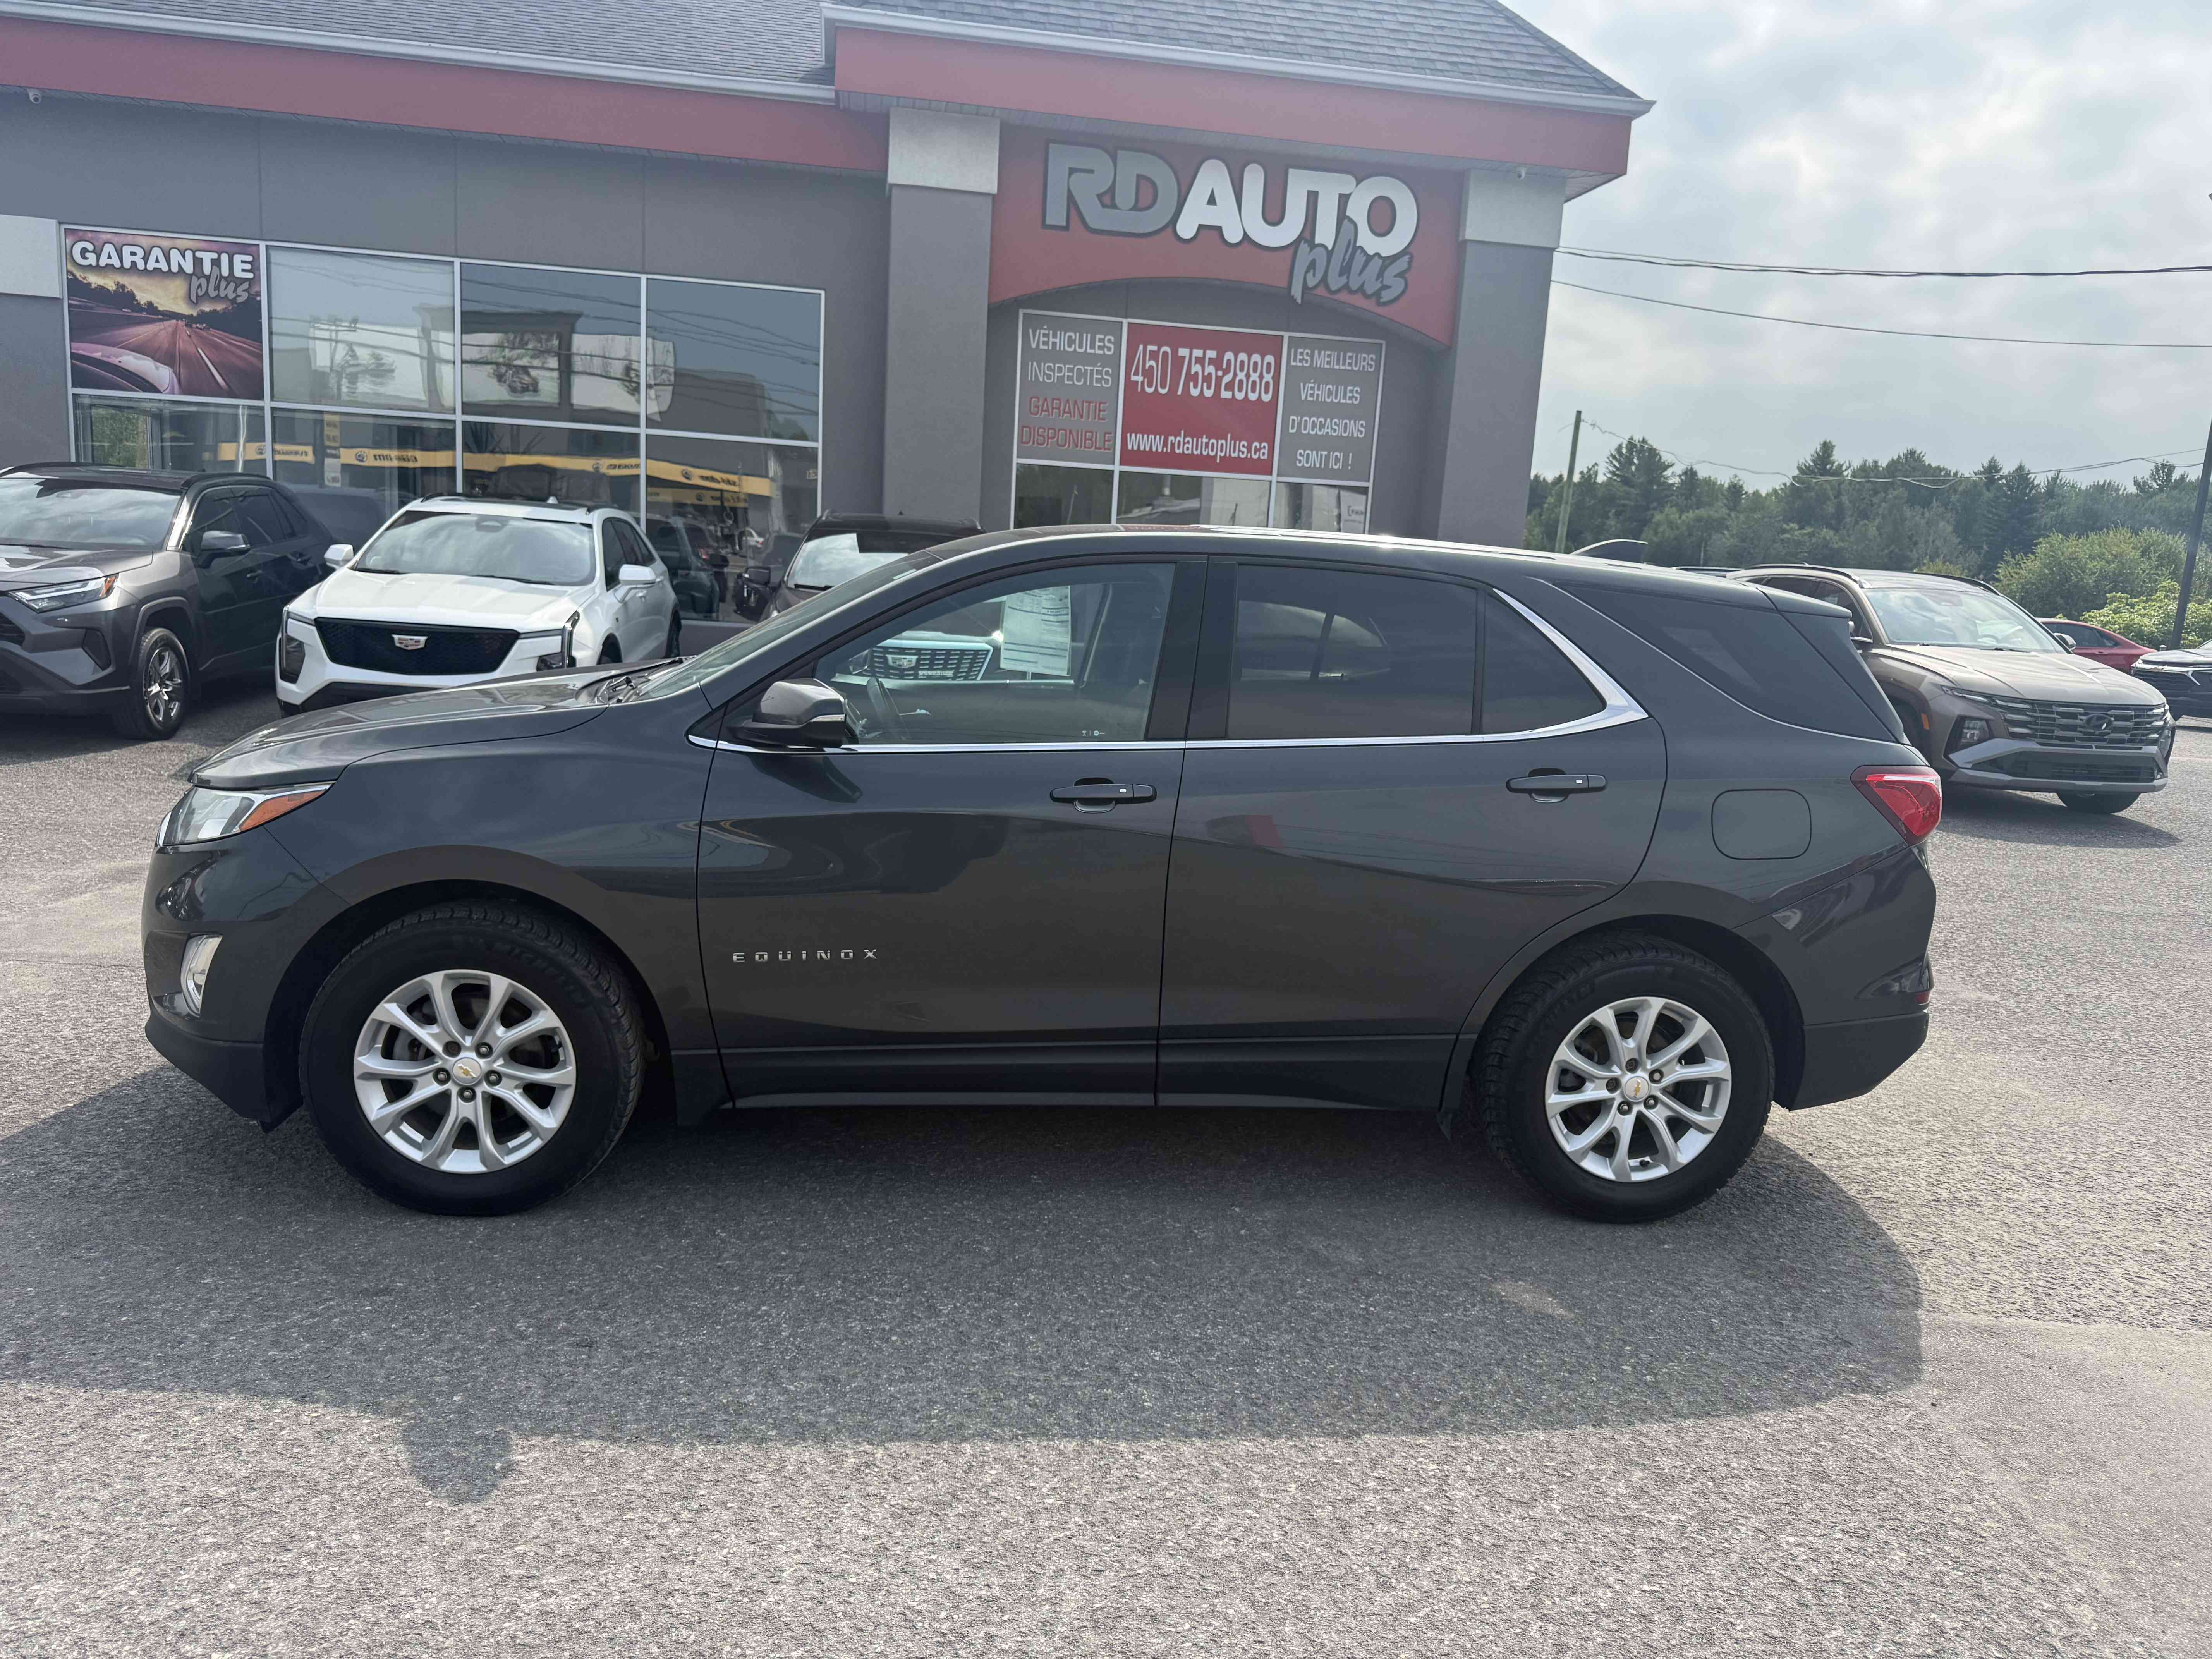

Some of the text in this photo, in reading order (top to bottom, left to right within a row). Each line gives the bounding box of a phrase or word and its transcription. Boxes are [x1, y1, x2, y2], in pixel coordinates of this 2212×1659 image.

[72, 241, 254, 279] GARANTIE
[1290, 216, 1412, 304] plus
[190, 265, 249, 304] plus
[1029, 325, 1114, 355] VÉHICULES
[1130, 344, 1275, 402] 450 755-2888
[1290, 348, 1376, 371] LES MEILLEURS
[1028, 361, 1112, 387] INSPECTÉS
[1300, 379, 1360, 404] VÉHICULES
[1028, 396, 1109, 422] GARANTIE
[1021, 425, 1113, 452] DISPONIBLE
[1127, 429, 1268, 463] www.rdautoplus.ca
[1296, 450, 1328, 468] SONT
[1329, 452, 1343, 469] ICI
[733, 949, 877, 963] EQUINOX
